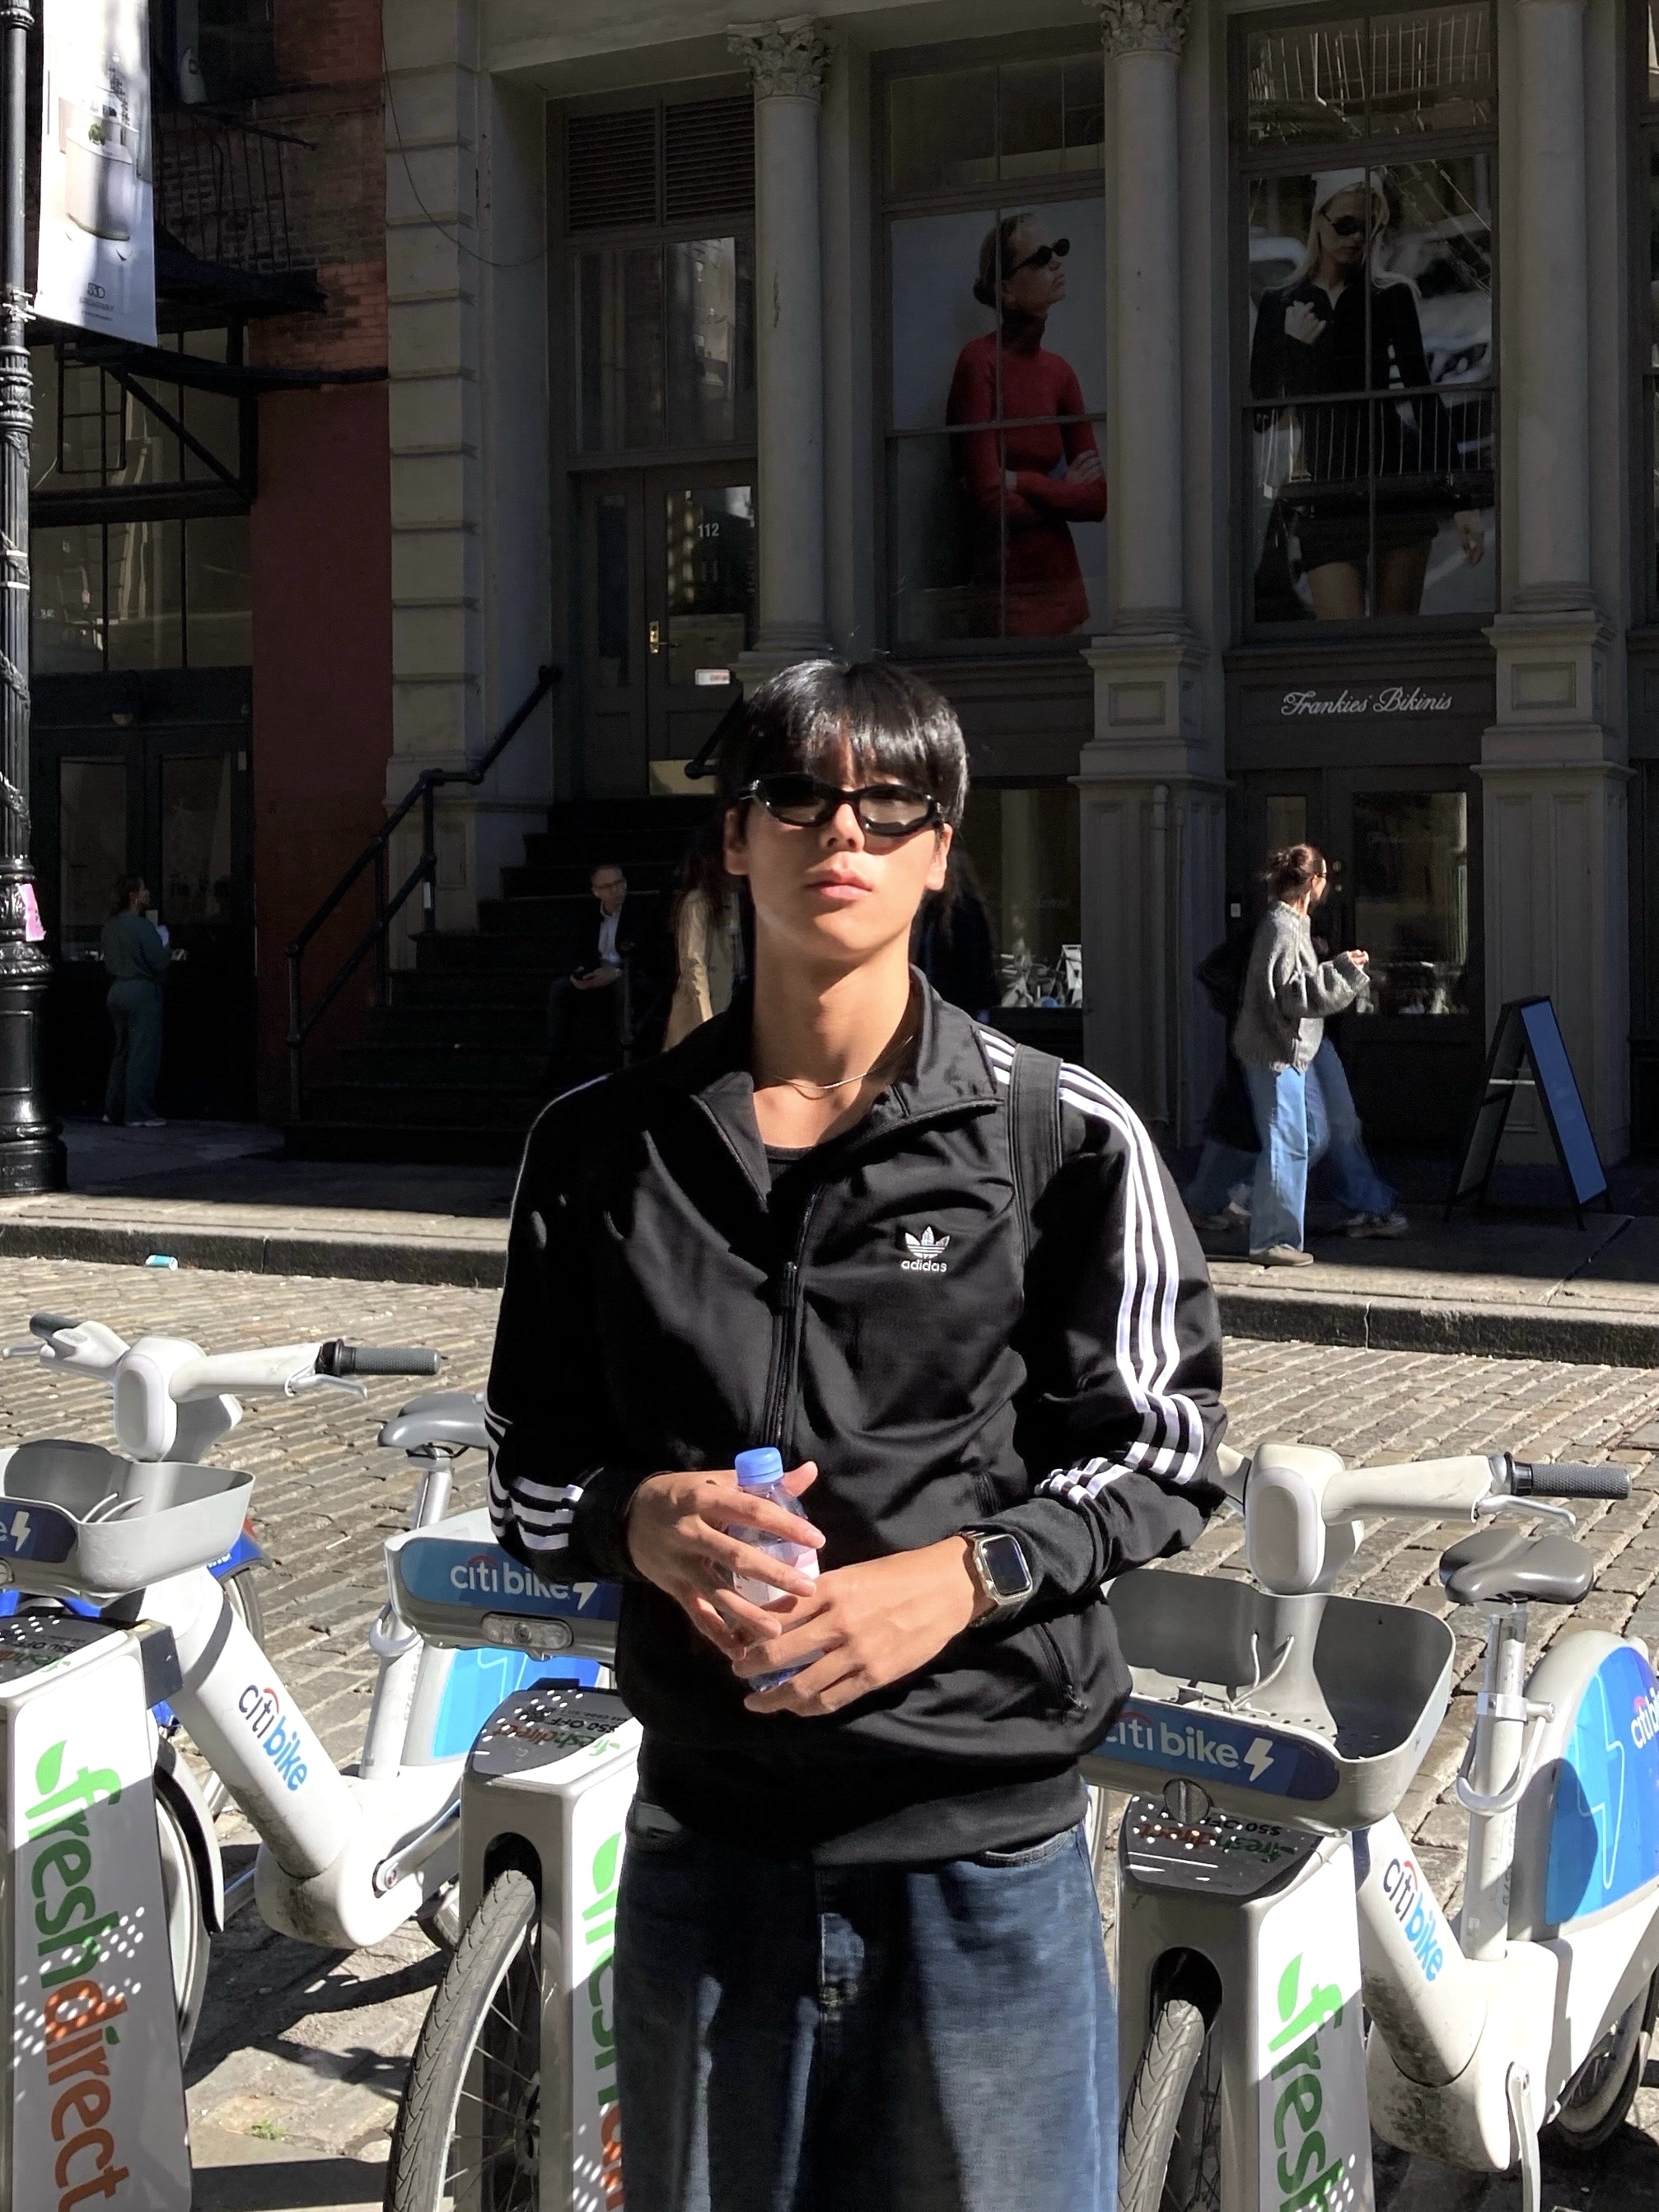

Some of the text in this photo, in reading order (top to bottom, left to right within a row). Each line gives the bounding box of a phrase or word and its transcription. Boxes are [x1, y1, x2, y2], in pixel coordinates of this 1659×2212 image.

[697, 523, 720, 538] 112
[1372, 686, 1452, 712] Bikinis
[901, 1259, 947, 1273] adidas
[451, 1555, 498, 1592] citi
[239, 1684, 307, 1791] citi bike
[1106, 1709, 1240, 1768] iti bike
[1245, 1822, 1283, 1836] $50
[1383, 1858, 1443, 1981] citi bike
